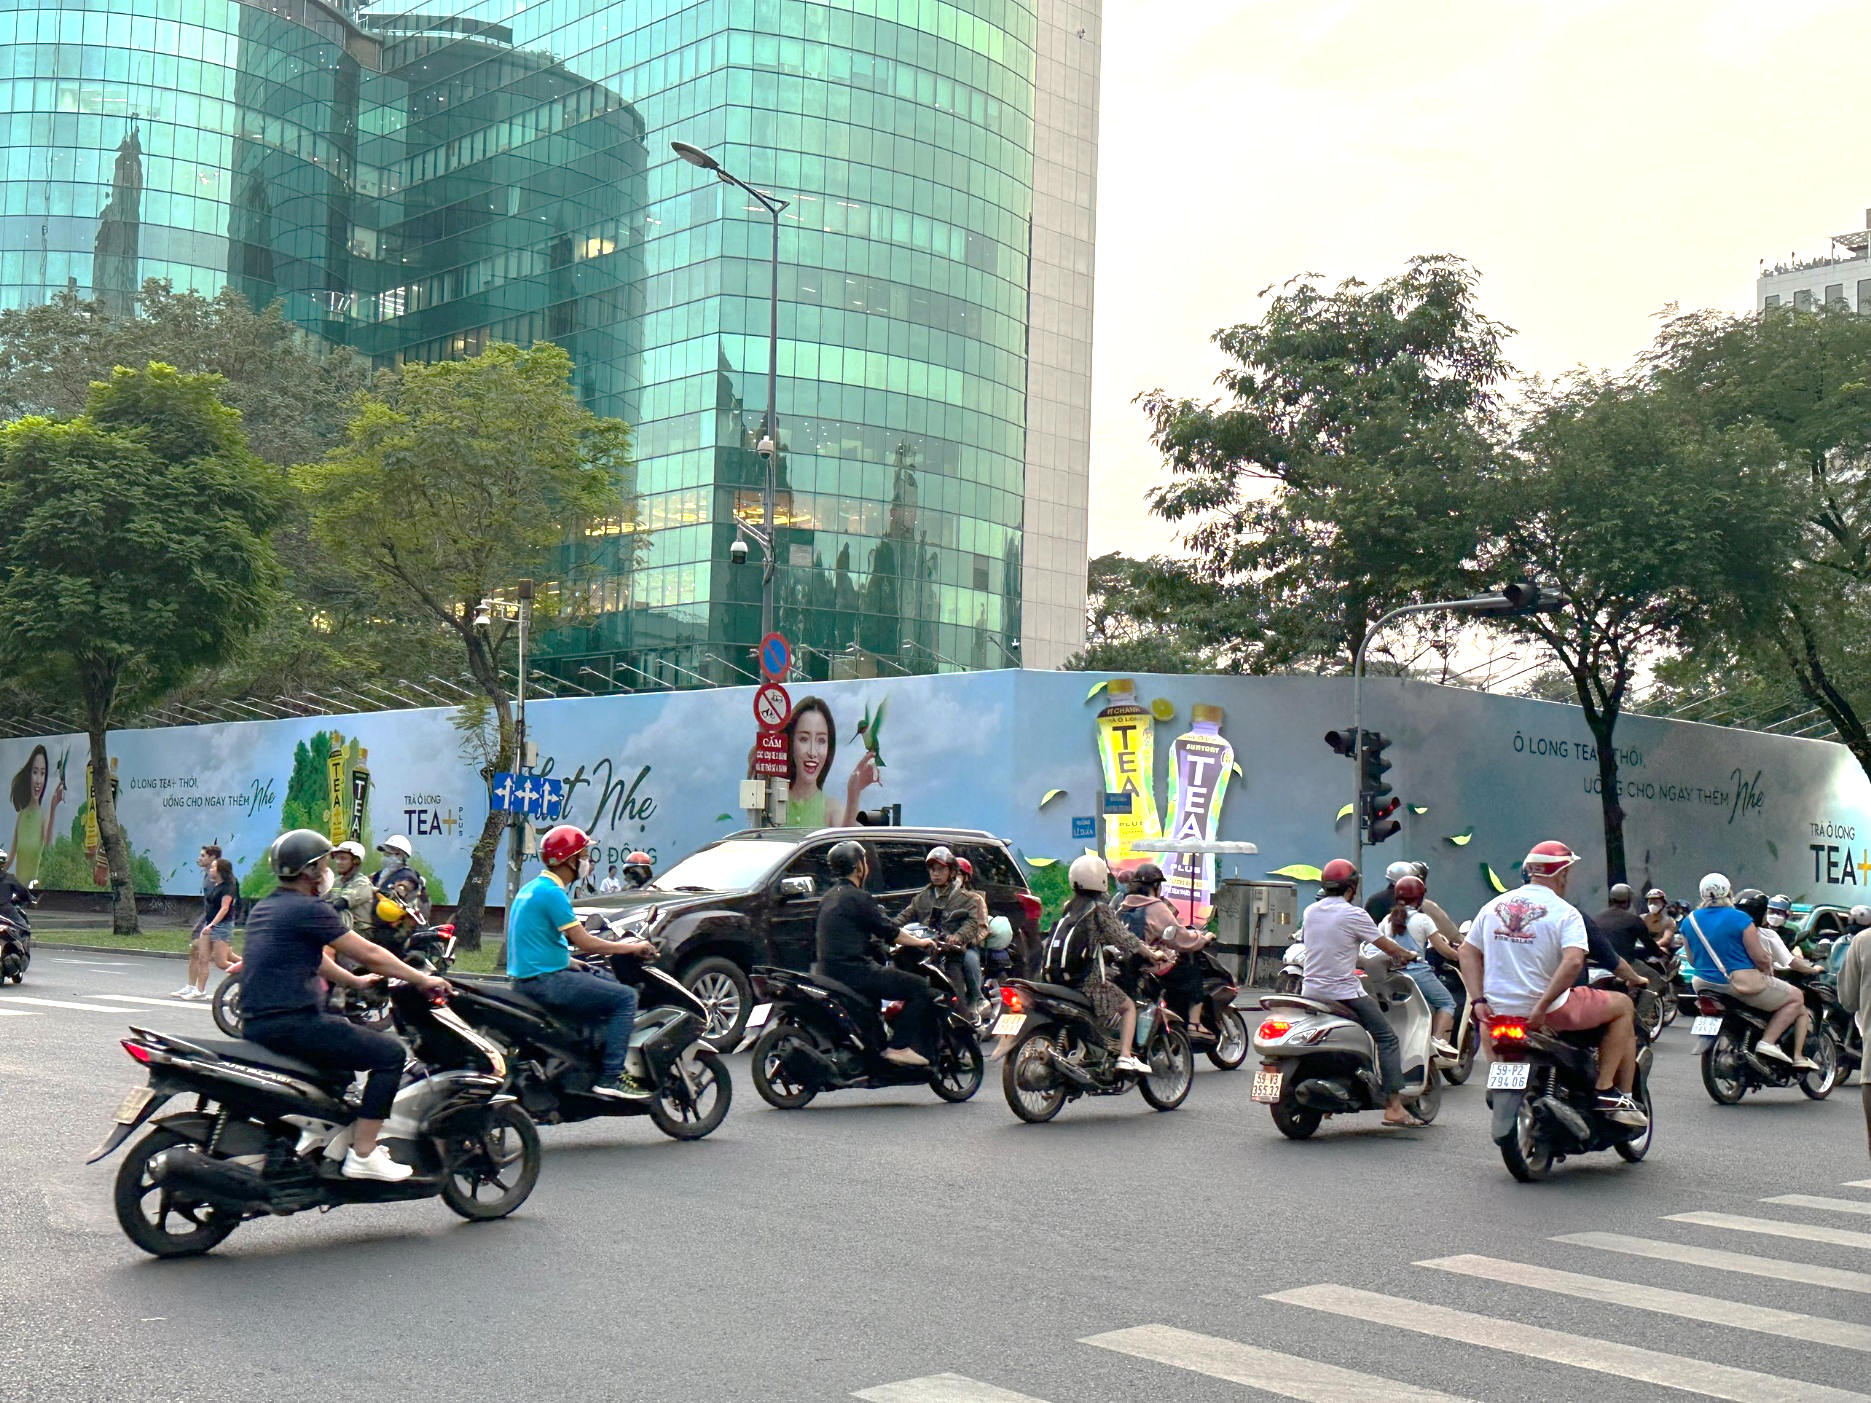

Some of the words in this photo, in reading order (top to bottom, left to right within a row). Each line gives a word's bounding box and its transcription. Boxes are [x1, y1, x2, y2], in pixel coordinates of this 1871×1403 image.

[762, 735, 782, 748] CẤM
[1529, 737, 1568, 758] LONG
[138, 778, 157, 789] LONG
[1627, 782, 1654, 799] CHO
[186, 797, 202, 807] CHO
[424, 795, 441, 805] LONG
[404, 808, 457, 835] TEA+
[1834, 825, 1855, 840] LONG
[1496, 1065, 1524, 1076] 59-P2
